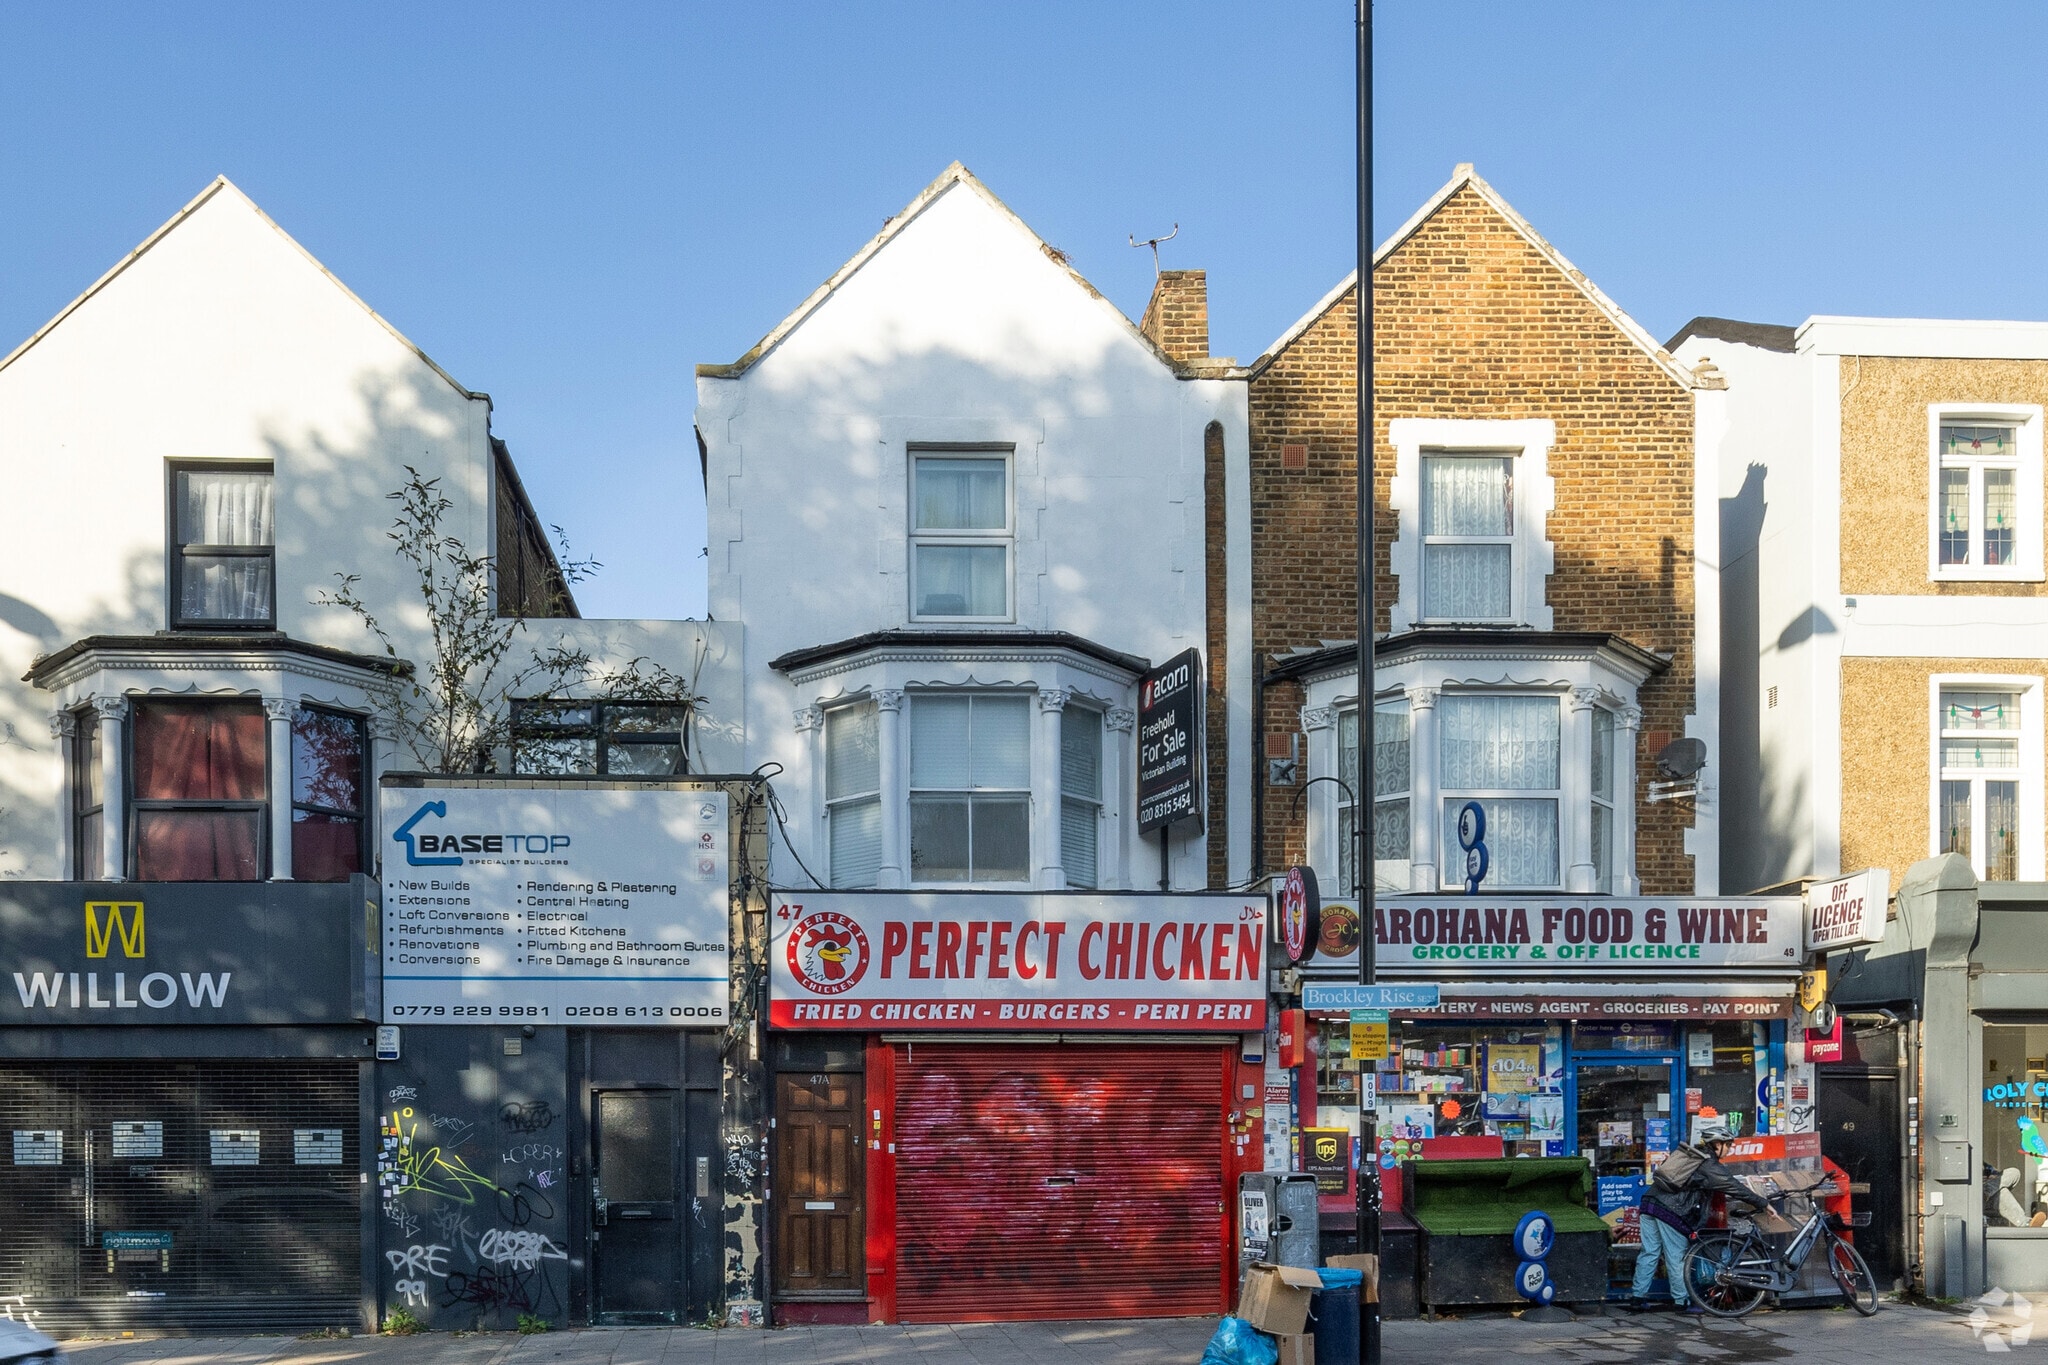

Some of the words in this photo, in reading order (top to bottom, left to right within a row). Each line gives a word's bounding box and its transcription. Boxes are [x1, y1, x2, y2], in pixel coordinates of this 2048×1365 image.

[1154, 664, 1188, 697] acorn
[1142, 710, 1175, 741] Freehold
[1142, 744, 1159, 766] For
[1163, 729, 1186, 757] Sale
[1142, 763, 1165, 781] Victorian
[1166, 754, 1187, 772] Building
[1141, 780, 1190, 806] acorncommercial.co.uk
[1141, 808, 1153, 824] 020
[1154, 800, 1172, 820] 8315
[1172, 792, 1191, 813] 5454
[399, 881, 427, 891] New
[431, 881, 470, 891] Builds
[527, 882, 594, 894] Rendering
[598, 882, 608, 892] &
[611, 882, 677, 895] Plastering
[1831, 883, 1848, 902] OFF
[399, 895, 471, 905] Extensions
[527, 896, 575, 907] Central
[579, 896, 629, 909] Heating
[399, 910, 425, 920] Loft
[428, 910, 510, 920] Conversions
[527, 911, 588, 921] Electrical
[777, 905, 803, 920] 47
[1239, 906, 1263, 920] حلال
[1812, 897, 1864, 931] LICENCE
[399, 925, 504, 935] Refurbishments
[527, 926, 567, 936] Fitted
[570, 926, 626, 936] Kitchens
[795, 913, 864, 937] PERFECT
[1375, 908, 1531, 944] AROHANA
[1542, 908, 1633, 944] FOOD
[1645, 908, 1666, 944] &
[1678, 908, 1768, 944] WINE
[1813, 928, 1830, 943] OPEN
[1830, 926, 1844, 939] TILL
[1844, 922, 1859, 936] LATE
[399, 939, 480, 950] Renovations
[527, 941, 587, 953] Plumbing
[590, 941, 613, 951] and
[616, 941, 681, 951] Bathroom
[684, 941, 725, 952] Suites
[880, 920, 1066, 980] PERFECT
[1077, 921, 1264, 982] CHICKEN
[1325, 944, 1349, 952] GROUP
[1413, 945, 1520, 959] GROCERY
[1530, 945, 1547, 959] &
[1557, 945, 1599, 959] OFF
[1609, 944, 1700, 959] LICENCE
[1783, 947, 1794, 957] 49
[399, 954, 480, 964] Conversions
[527, 956, 553, 966] Fire
[556, 956, 609, 968] Damage
[613, 956, 623, 966] &
[626, 956, 690, 966] Insurance
[12, 972, 231, 1008] WILLOW
[802, 979, 855, 993] CHICKEN
[1308, 989, 1373, 1006] Brockley
[1380, 989, 1414, 1003] Rise
[393, 1006, 445, 1016] 0779
[453, 1006, 492, 1016] 229
[499, 1006, 550, 1016] 9981
[566, 1006, 618, 1017] 0208
[625, 1007, 664, 1017] 613
[670, 1007, 722, 1017] 0006
[793, 1003, 862, 1020] FRIED
[869, 1003, 975, 1020] CHICKEN
[998, 1003, 1110, 1020] BURGERS
[1133, 1004, 1189, 1020] PERI
[1196, 1004, 1253, 1021] PERI
[1491, 1003, 1534, 1013] NEWS
[1539, 1003, 1589, 1013] AGENT
[1602, 1003, 1688, 1014] GROCERIES
[1702, 1003, 1732, 1014] PAY
[1735, 1003, 1780, 1014] POINT
[1280, 1032, 1292, 1046] Sun
[1812, 1042, 1839, 1056] payzone
[809, 1074, 830, 1085] 47A
[2032, 1082, 2048, 1097] C
[1842, 1122, 1855, 1132] 49
[1317, 1144, 1335, 1158] ups
[1244, 1198, 1263, 1207] OLIVER
[105, 1237, 161, 1248] rightmove
[1528, 1271, 1542, 1281] PLAY
[1529, 1277, 1543, 1287] NOW
